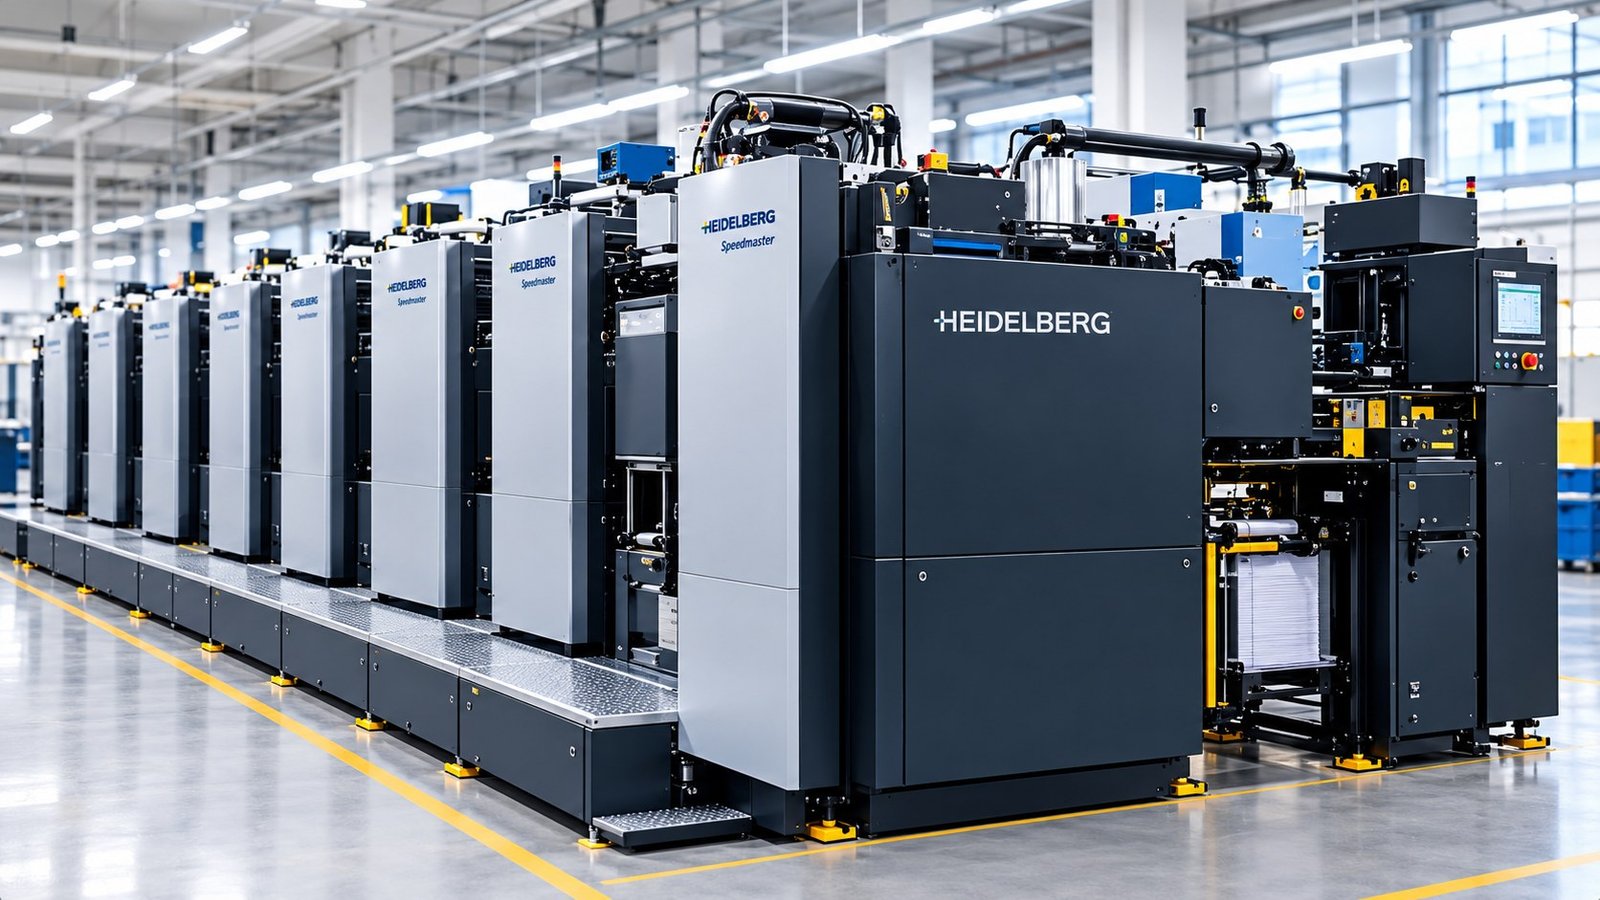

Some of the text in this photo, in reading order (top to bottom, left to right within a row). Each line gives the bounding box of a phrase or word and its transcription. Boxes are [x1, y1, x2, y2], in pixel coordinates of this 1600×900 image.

[701, 210, 776, 235] HEIDELBERG
[721, 235, 775, 254] Speedmaster
[508, 255, 556, 274] HEIDELBERG
[386, 277, 427, 293] HEIDELBERG
[521, 276, 556, 290] Speedmaster
[933, 310, 1111, 334] HEIDELBERG
